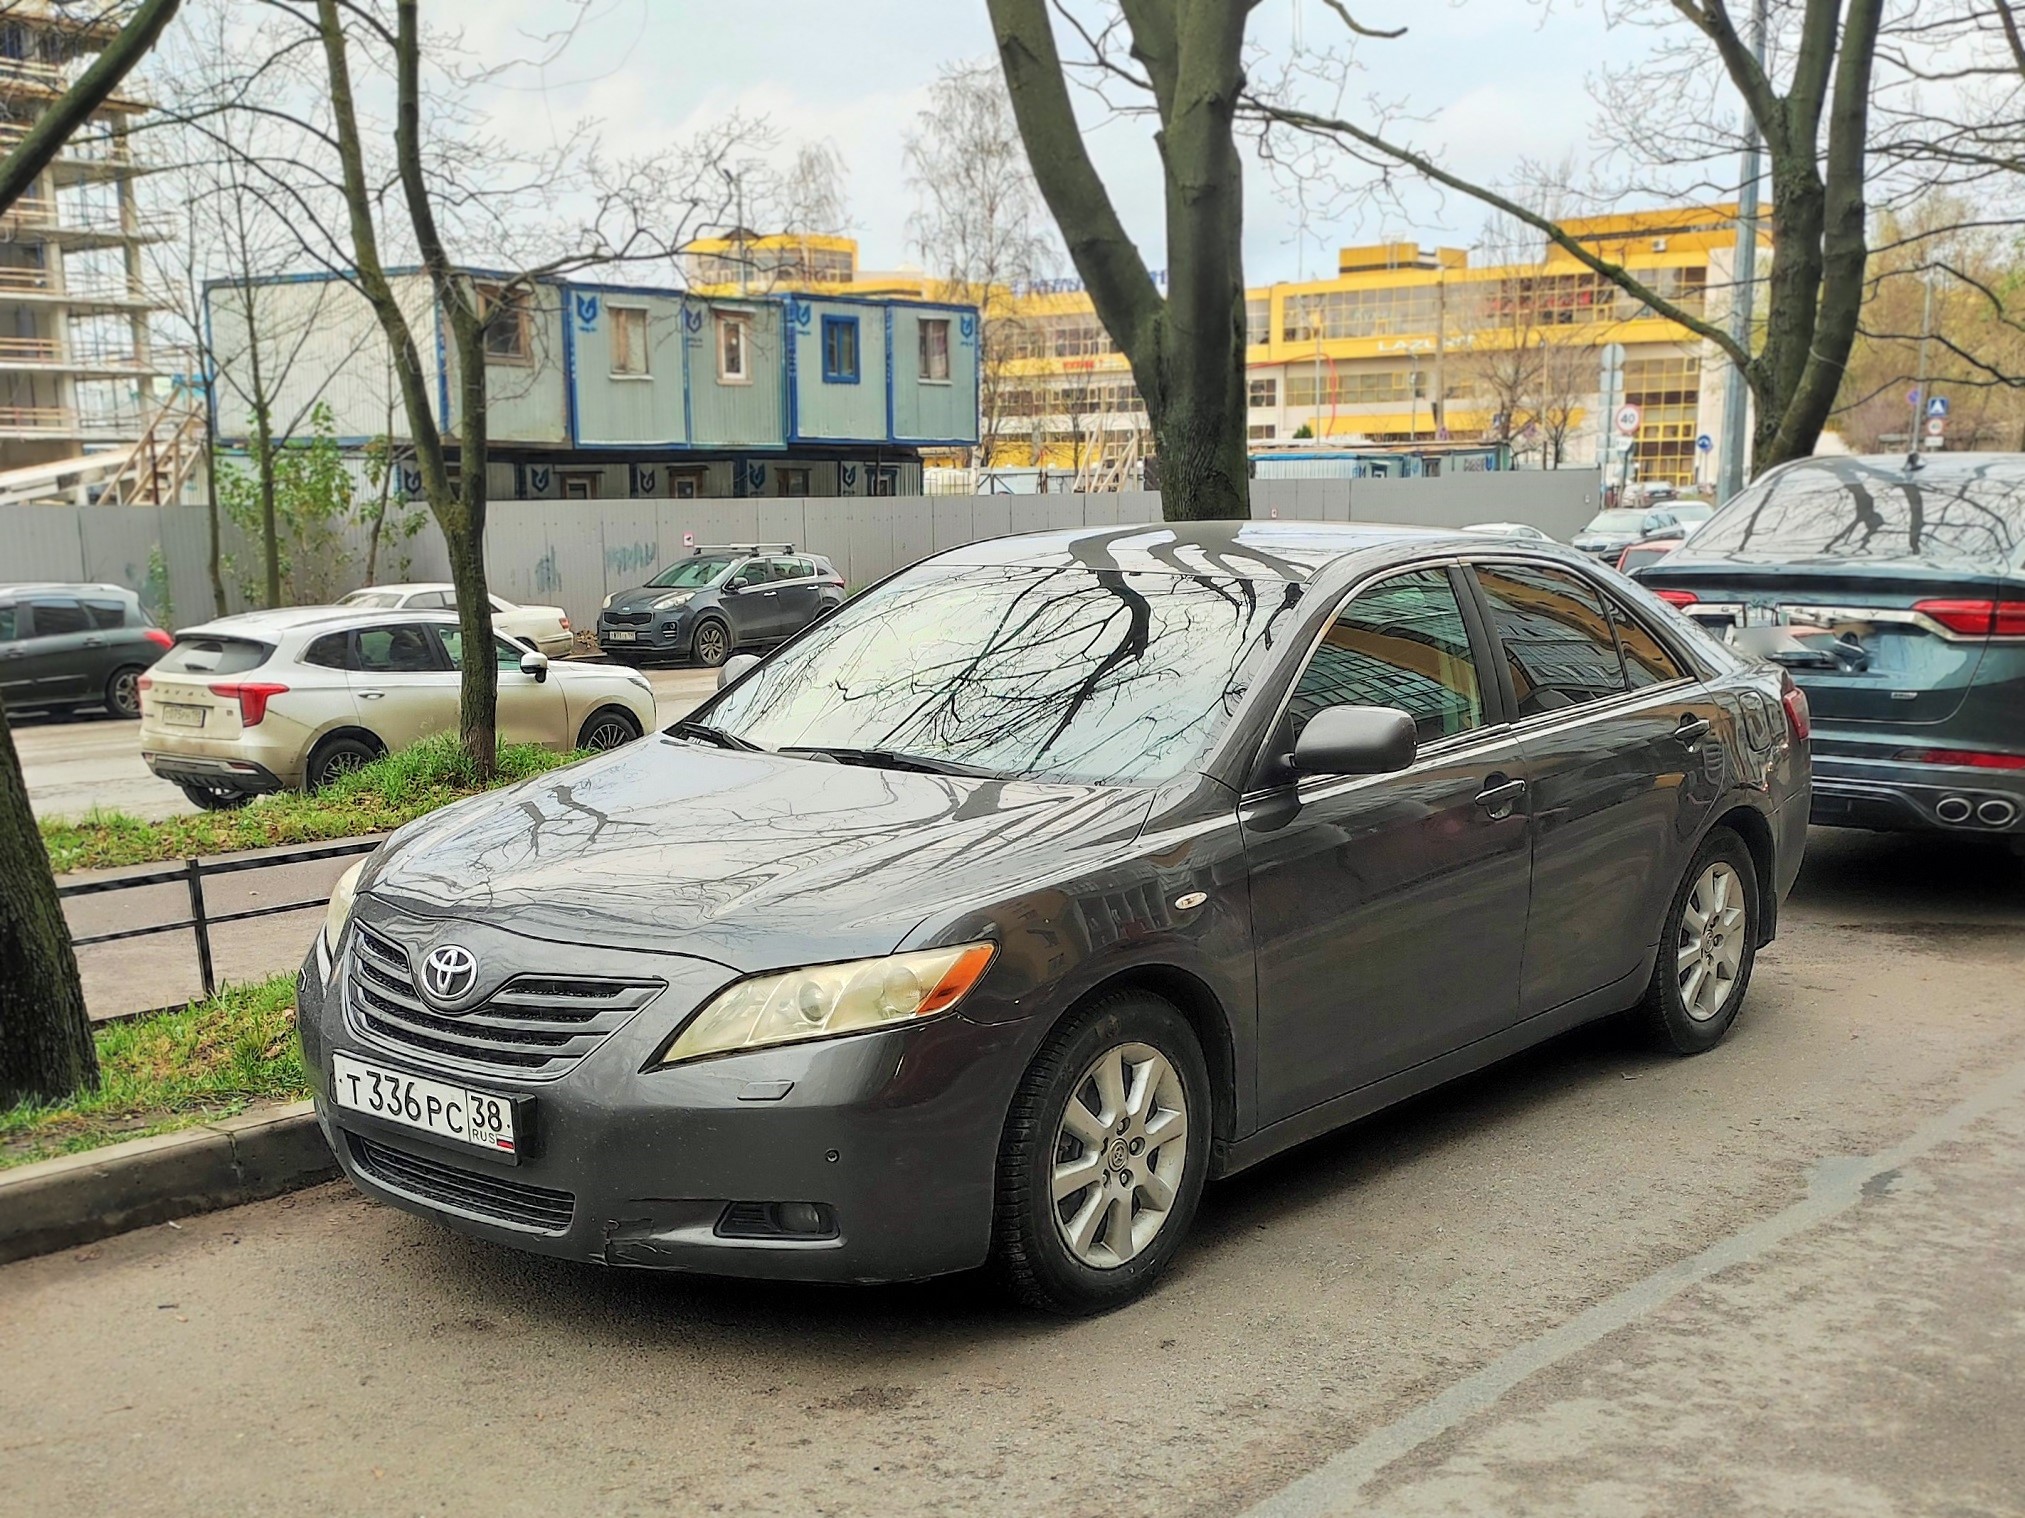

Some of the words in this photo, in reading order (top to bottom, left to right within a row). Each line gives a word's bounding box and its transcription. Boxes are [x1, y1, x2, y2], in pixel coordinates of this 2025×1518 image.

[1620, 413, 1635, 424] 40
[346, 1069, 463, 1133] Т336РС
[470, 1095, 503, 1132] 38
[472, 1128, 496, 1144] RUS
